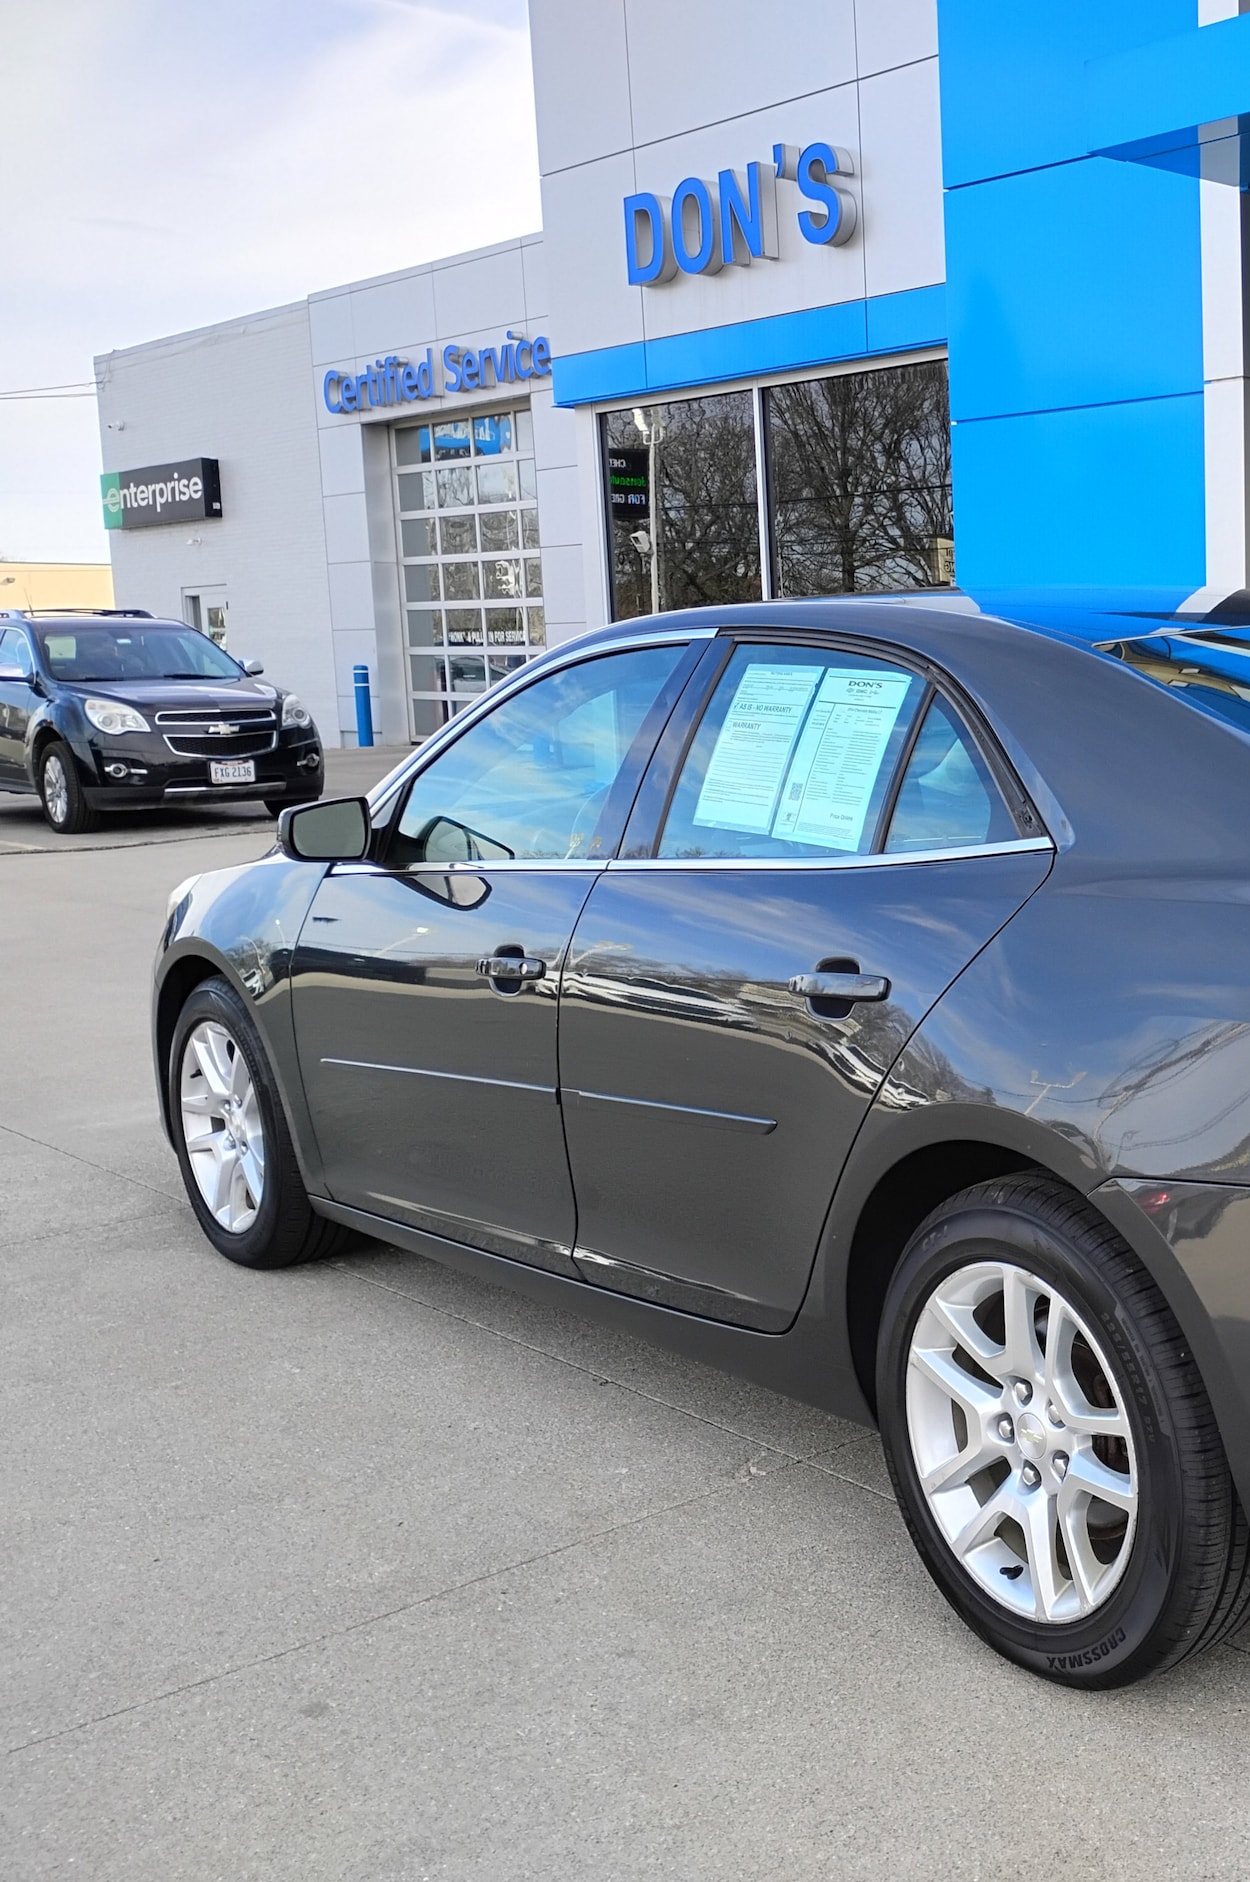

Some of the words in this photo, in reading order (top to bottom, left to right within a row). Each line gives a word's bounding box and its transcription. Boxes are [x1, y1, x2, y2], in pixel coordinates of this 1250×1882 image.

[623, 142, 848, 286] DON'S
[323, 348, 435, 414] Certified
[443, 330, 552, 393] Service
[103, 472, 203, 512] enterprise
[848, 680, 883, 689] DON'S
[763, 705, 792, 713] WARRANTY
[732, 721, 762, 730] WARRANTY
[214, 767, 230, 778] FXG
[232, 766, 252, 778] 2136
[1046, 1627, 1126, 1669] CROSSMAX
